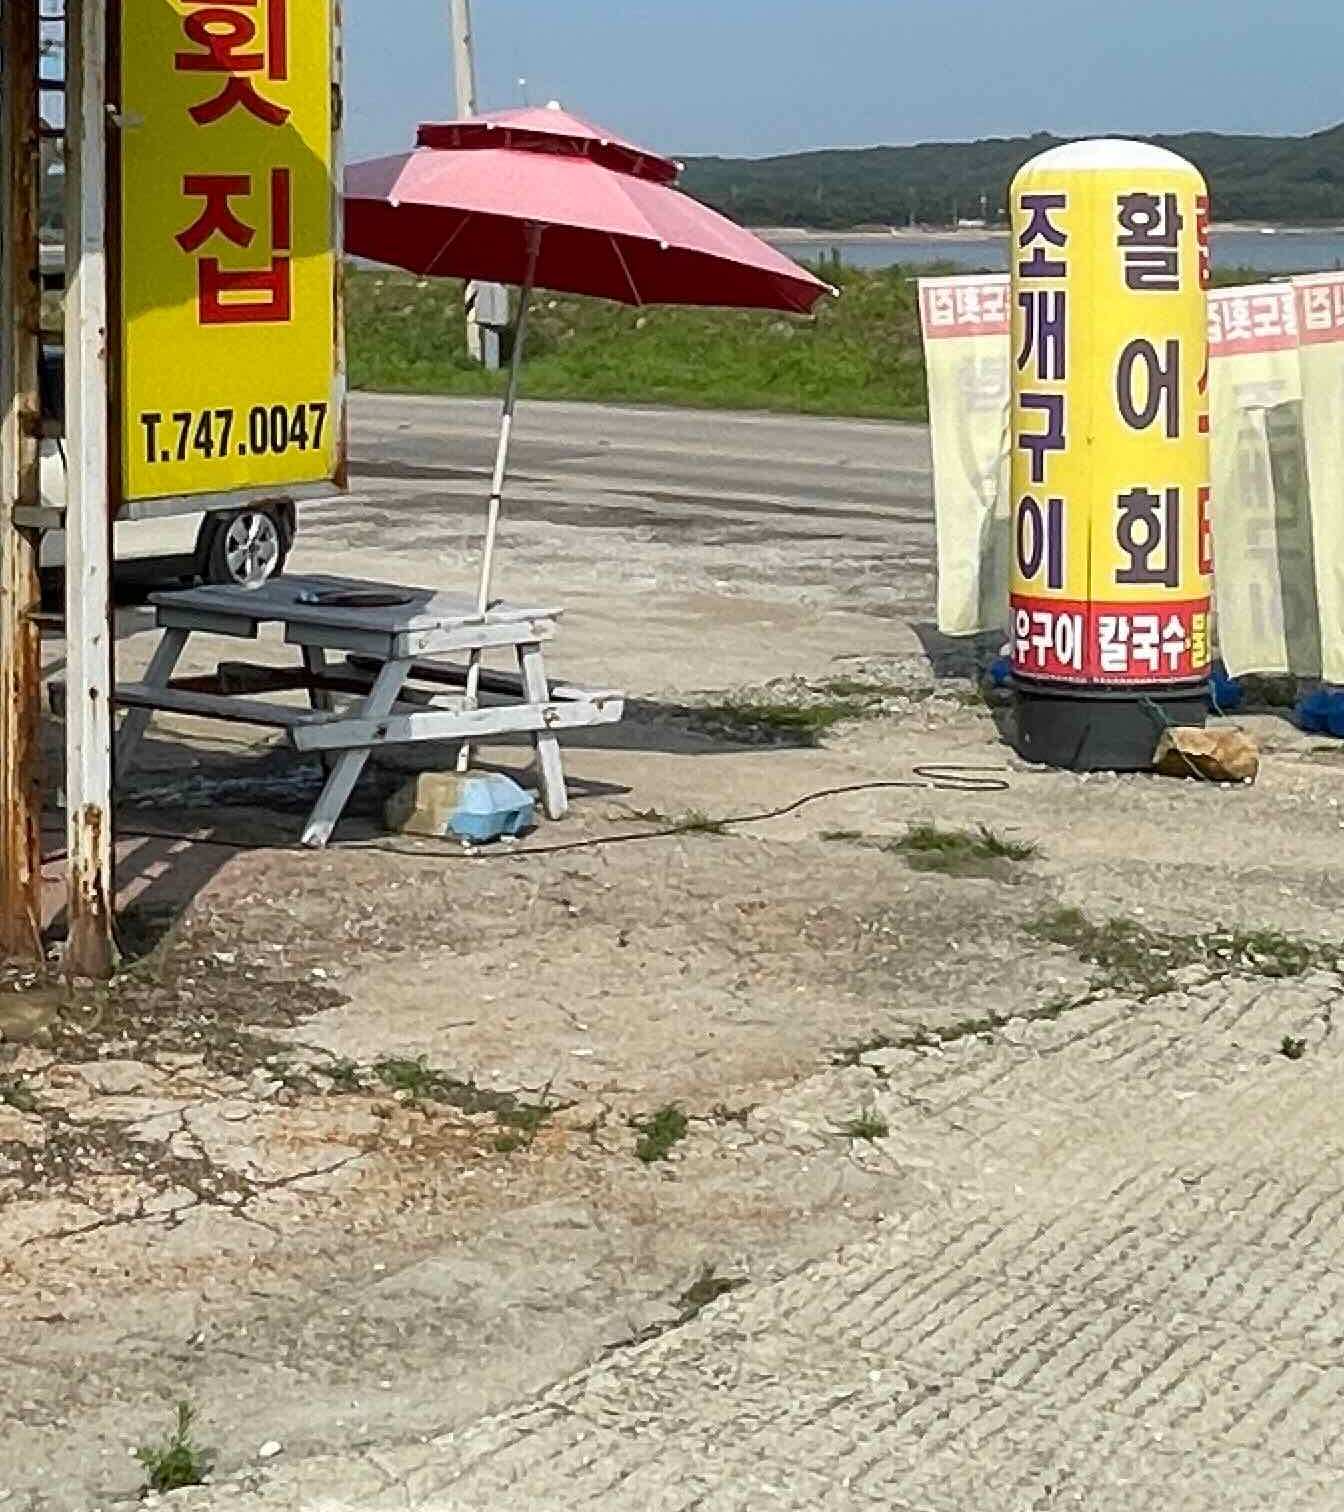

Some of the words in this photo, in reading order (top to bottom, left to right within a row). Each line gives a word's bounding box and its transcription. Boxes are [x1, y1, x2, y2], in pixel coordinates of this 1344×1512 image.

[140, 402, 328, 463] T.747.0047
[1016, 194, 1067, 590] 조개구이
[1115, 192, 1183, 589] 활어회
[1010, 608, 1083, 671] 우구이
